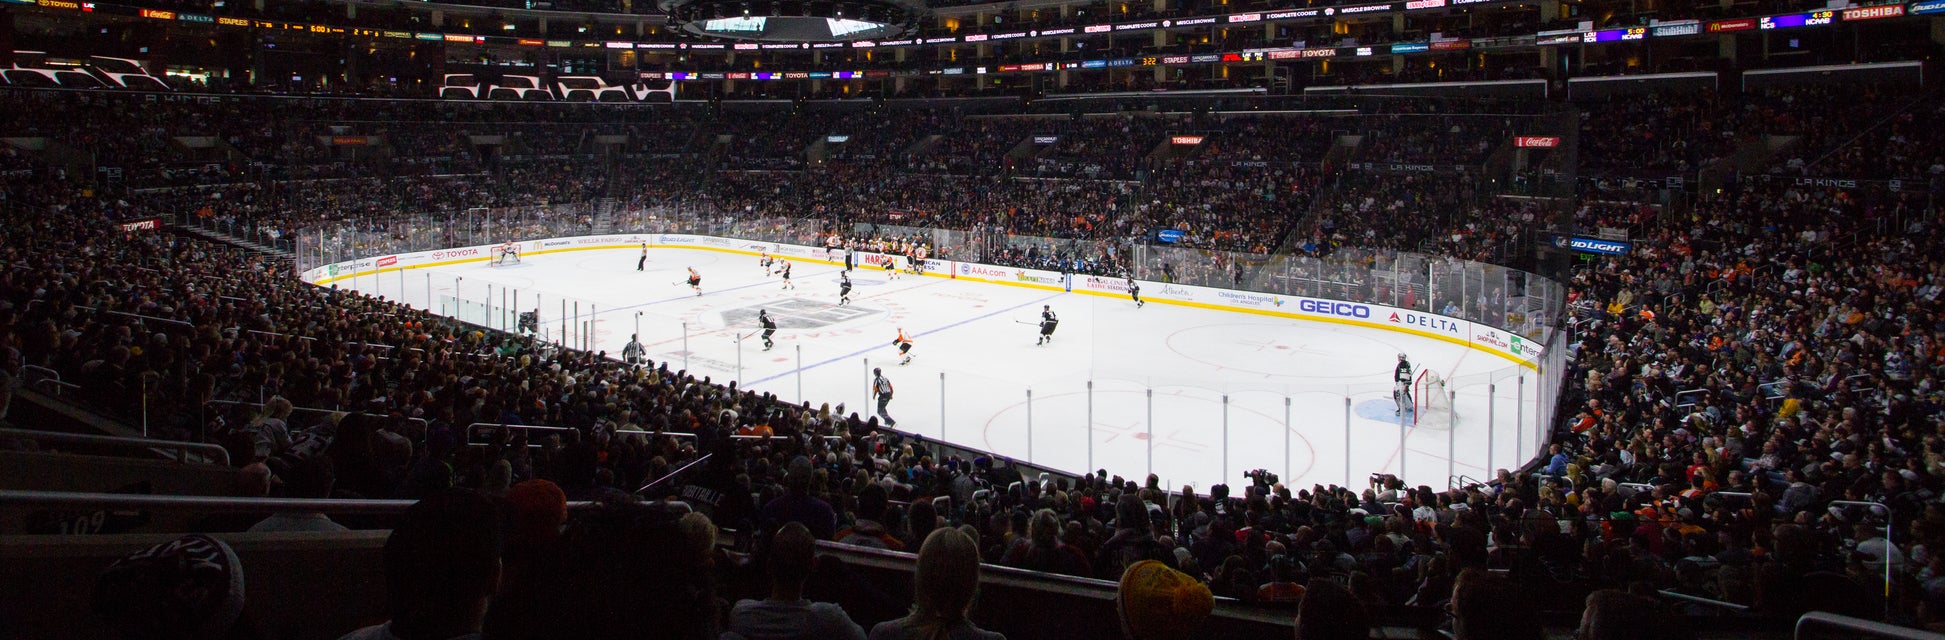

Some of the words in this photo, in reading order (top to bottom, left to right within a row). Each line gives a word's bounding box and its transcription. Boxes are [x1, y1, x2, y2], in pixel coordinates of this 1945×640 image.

[50, 0, 79, 8] TOYOTA
[1844, 6, 1903, 19] TOSHIBA
[218, 17, 248, 26] STAPLES
[1302, 49, 1336, 57] TOYOTA
[1795, 178, 1812, 186] LA
[1816, 178, 1856, 188] KINGS
[123, 220, 154, 231] TOYOTA
[1571, 240, 1586, 248] UD
[1586, 241, 1626, 252] LIGHT
[447, 248, 479, 257] TOYOTA
[971, 266, 1007, 278] AAA.com
[1218, 291, 1246, 300] Children's
[1247, 294, 1274, 303] Hospital
[1300, 299, 1370, 319] GEICO
[1406, 313, 1458, 333] DELTA
